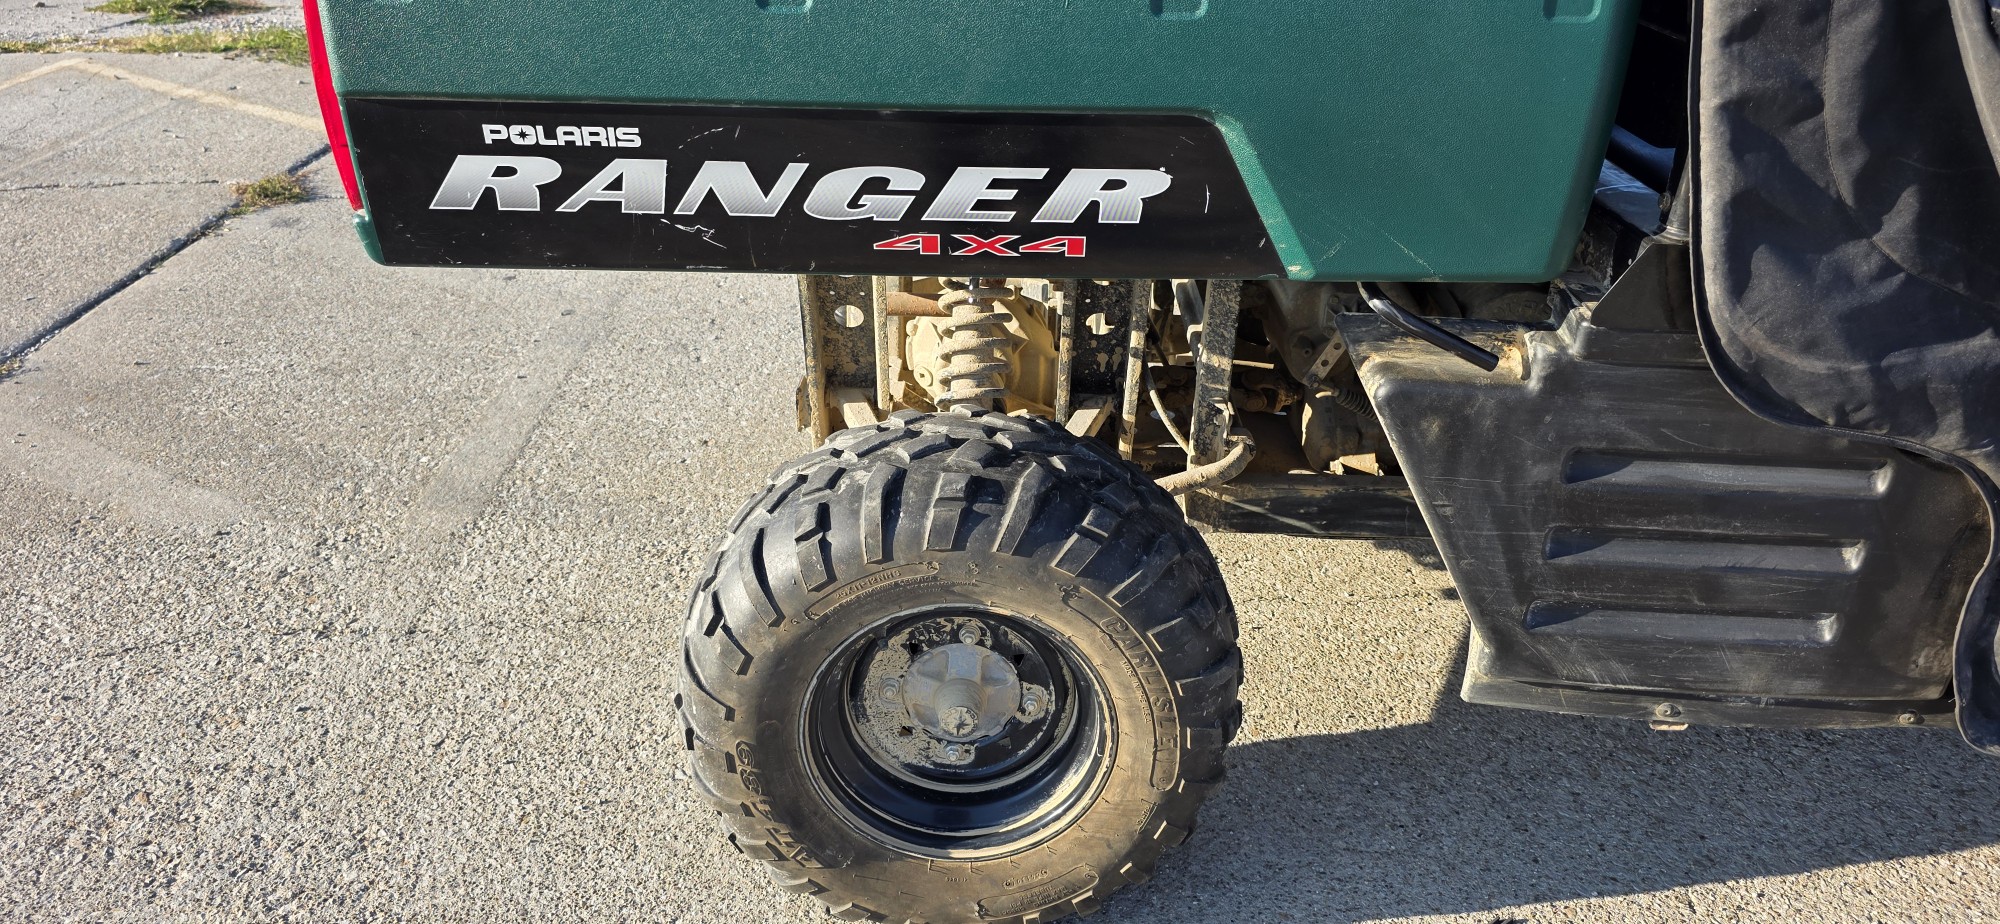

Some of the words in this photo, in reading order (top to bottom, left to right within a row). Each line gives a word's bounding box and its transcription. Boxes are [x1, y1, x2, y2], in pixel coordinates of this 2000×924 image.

[482, 124, 642, 148] POLARIS
[429, 154, 1173, 224] RANGER
[1100, 616, 1178, 750] CARLISLE
